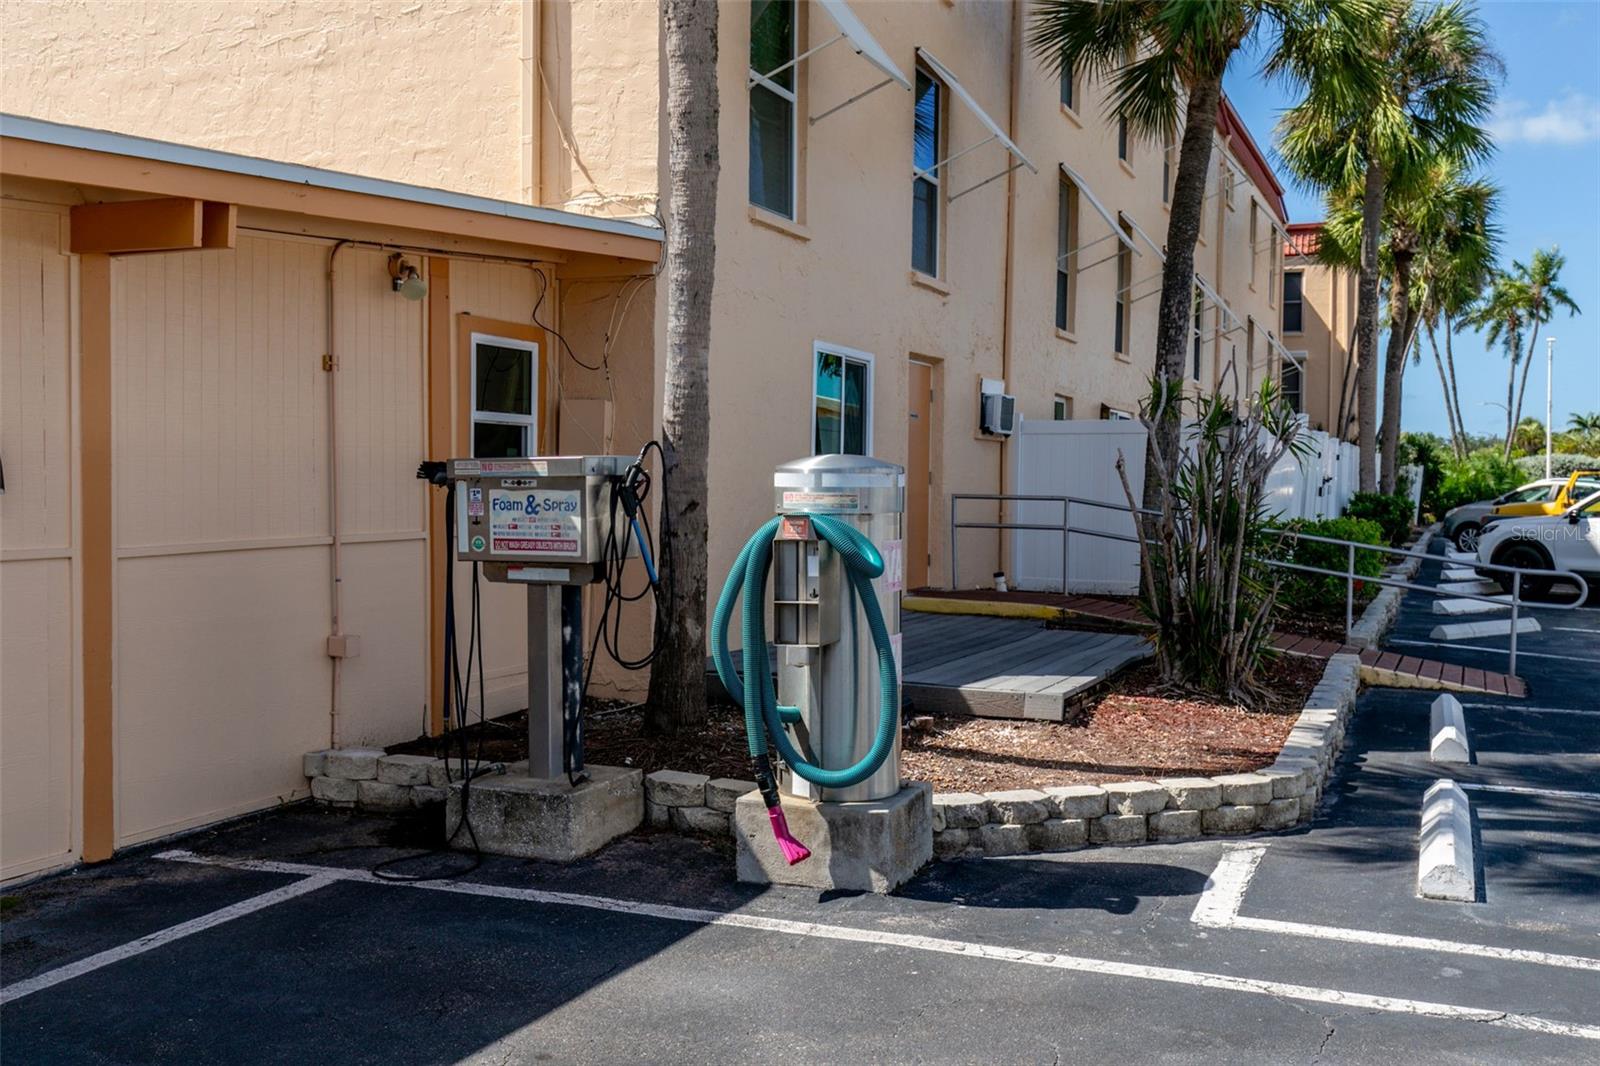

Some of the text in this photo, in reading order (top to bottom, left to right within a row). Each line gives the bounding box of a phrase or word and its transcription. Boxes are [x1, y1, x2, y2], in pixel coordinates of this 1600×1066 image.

[492, 498, 523, 511] Foam
[525, 494, 541, 515] &
[543, 498, 577, 512] Spray
